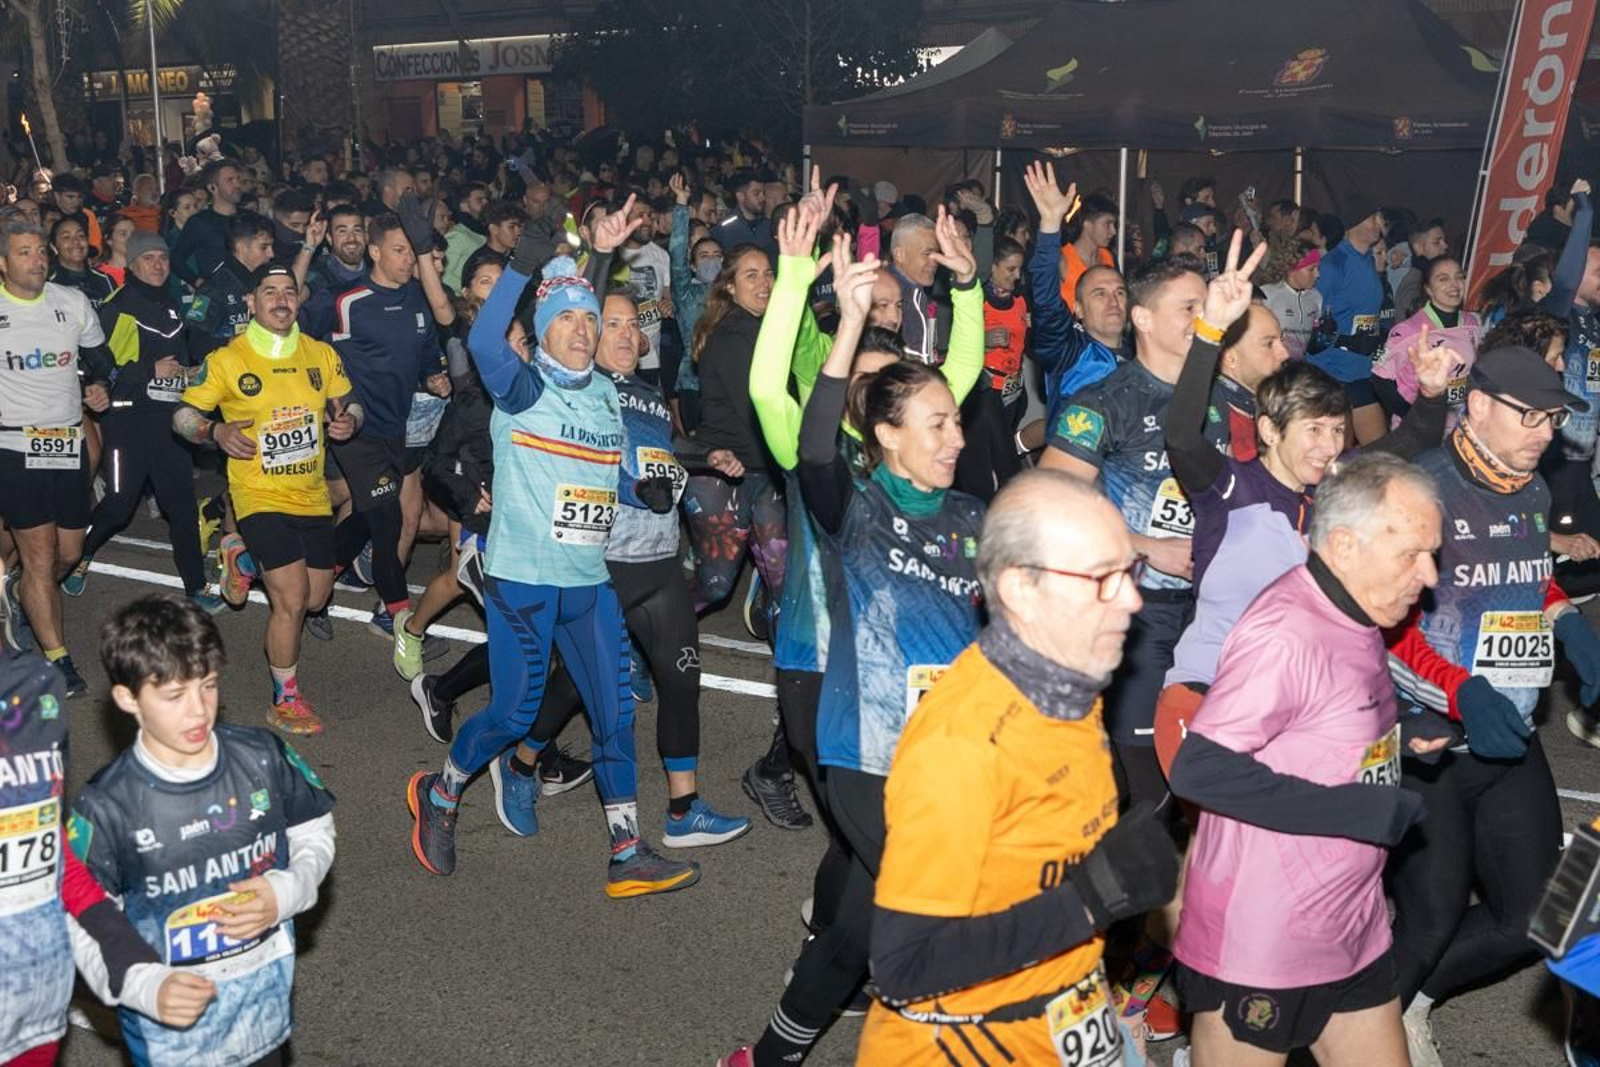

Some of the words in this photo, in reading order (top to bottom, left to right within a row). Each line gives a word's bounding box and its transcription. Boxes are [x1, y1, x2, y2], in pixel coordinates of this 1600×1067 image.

[377, 49, 481, 77] CONFECCIONS
[6, 348, 73, 370] indea
[31, 438, 74, 452] 6591
[265, 426, 313, 450] 9091
[561, 502, 614, 524] 5123
[1453, 562, 1500, 587] SAN
[1482, 635, 1551, 658] 10025
[145, 864, 198, 898] SAN
[204, 832, 277, 884] ANTÓN
